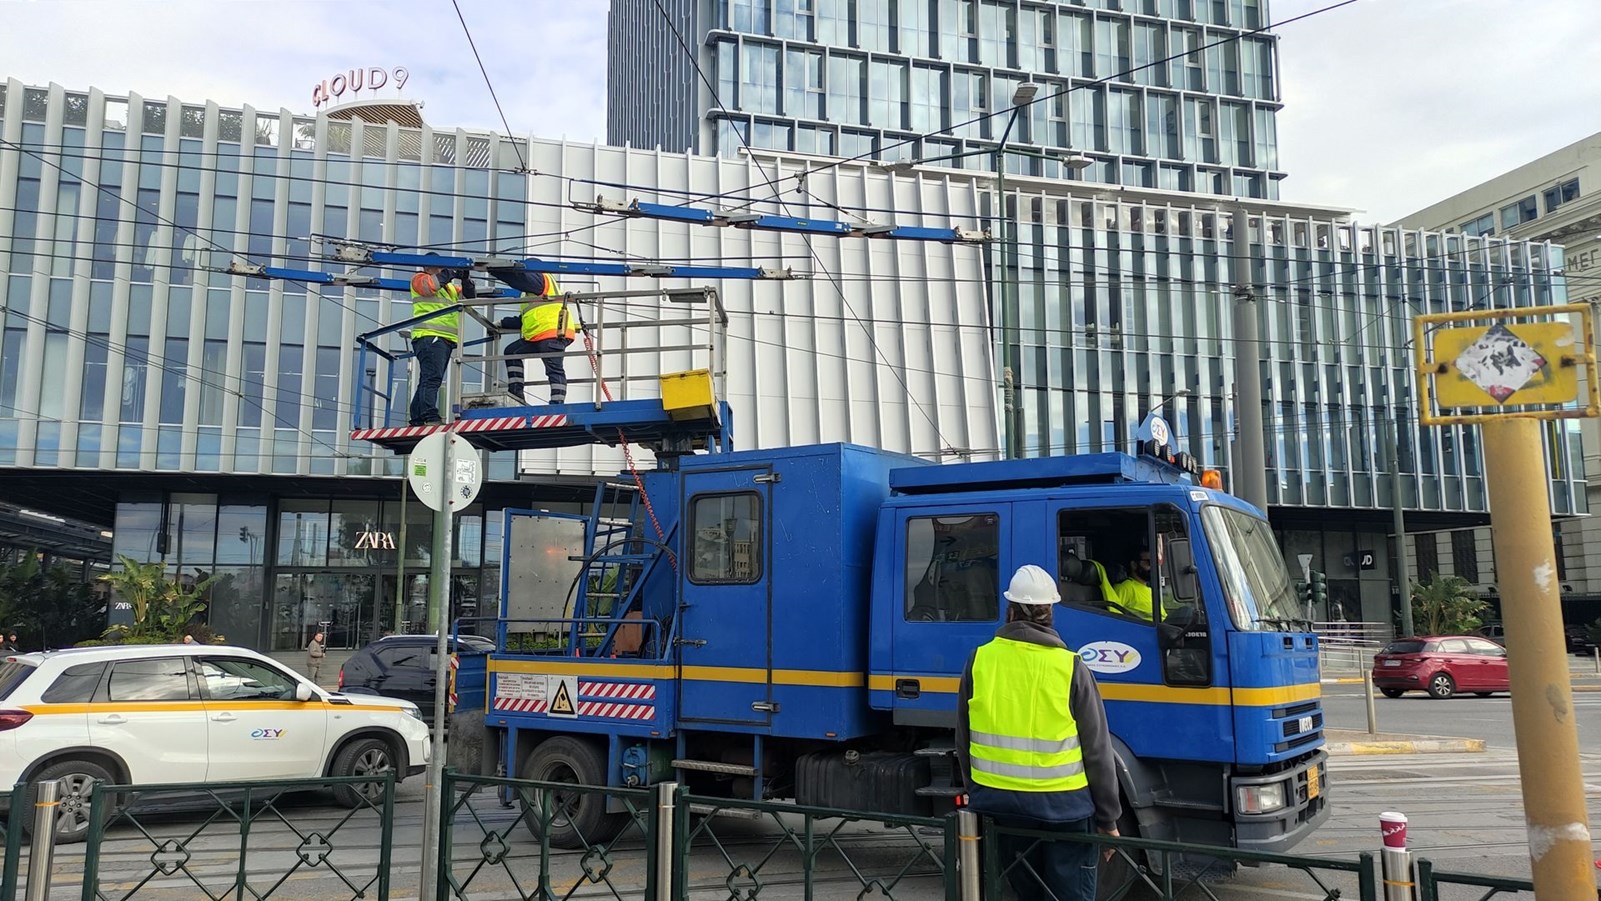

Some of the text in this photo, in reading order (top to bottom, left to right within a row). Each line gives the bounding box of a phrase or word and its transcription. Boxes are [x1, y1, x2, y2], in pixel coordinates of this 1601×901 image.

[313, 66, 409, 107] CLOUD 9
[354, 531, 398, 550] ZARA
[1361, 554, 1373, 566] JD
